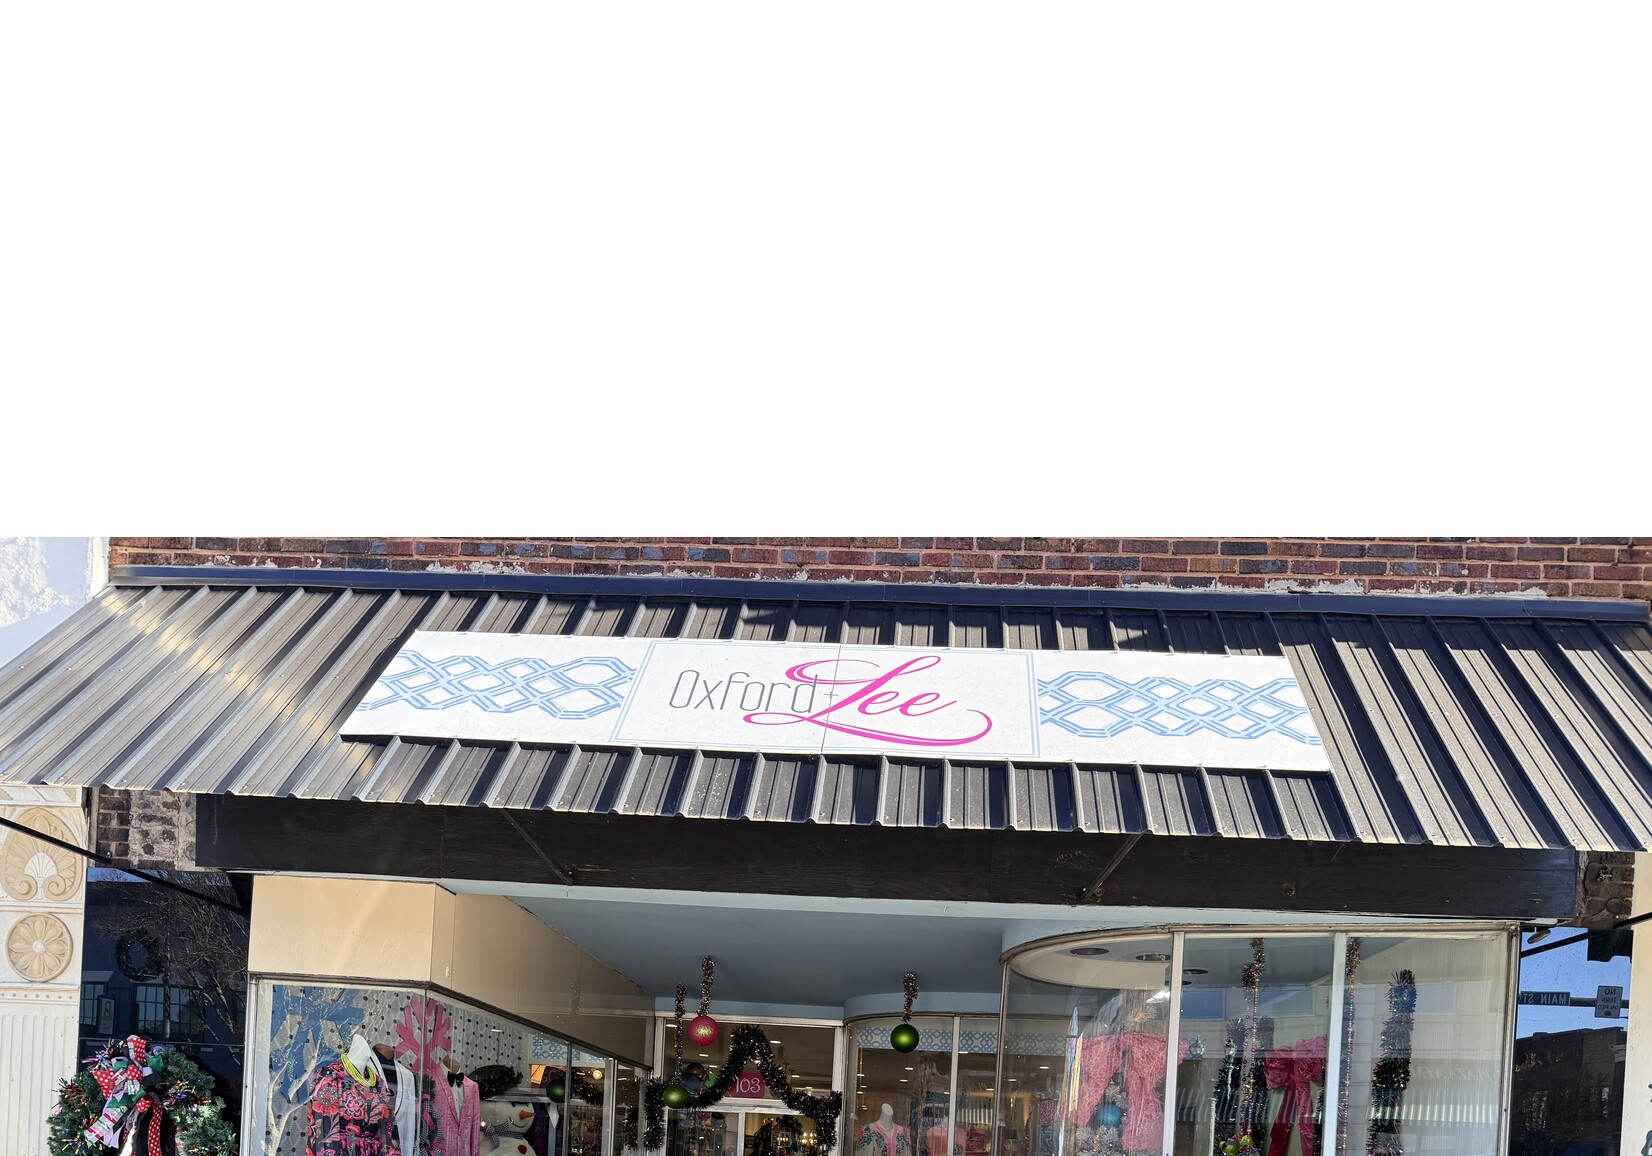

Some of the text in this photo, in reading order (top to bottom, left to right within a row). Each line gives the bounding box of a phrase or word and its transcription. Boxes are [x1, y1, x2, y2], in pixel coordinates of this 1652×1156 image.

[668, 669, 819, 714] Oxford
[742, 654, 993, 747] Lee
[735, 1076, 761, 1093] 103
